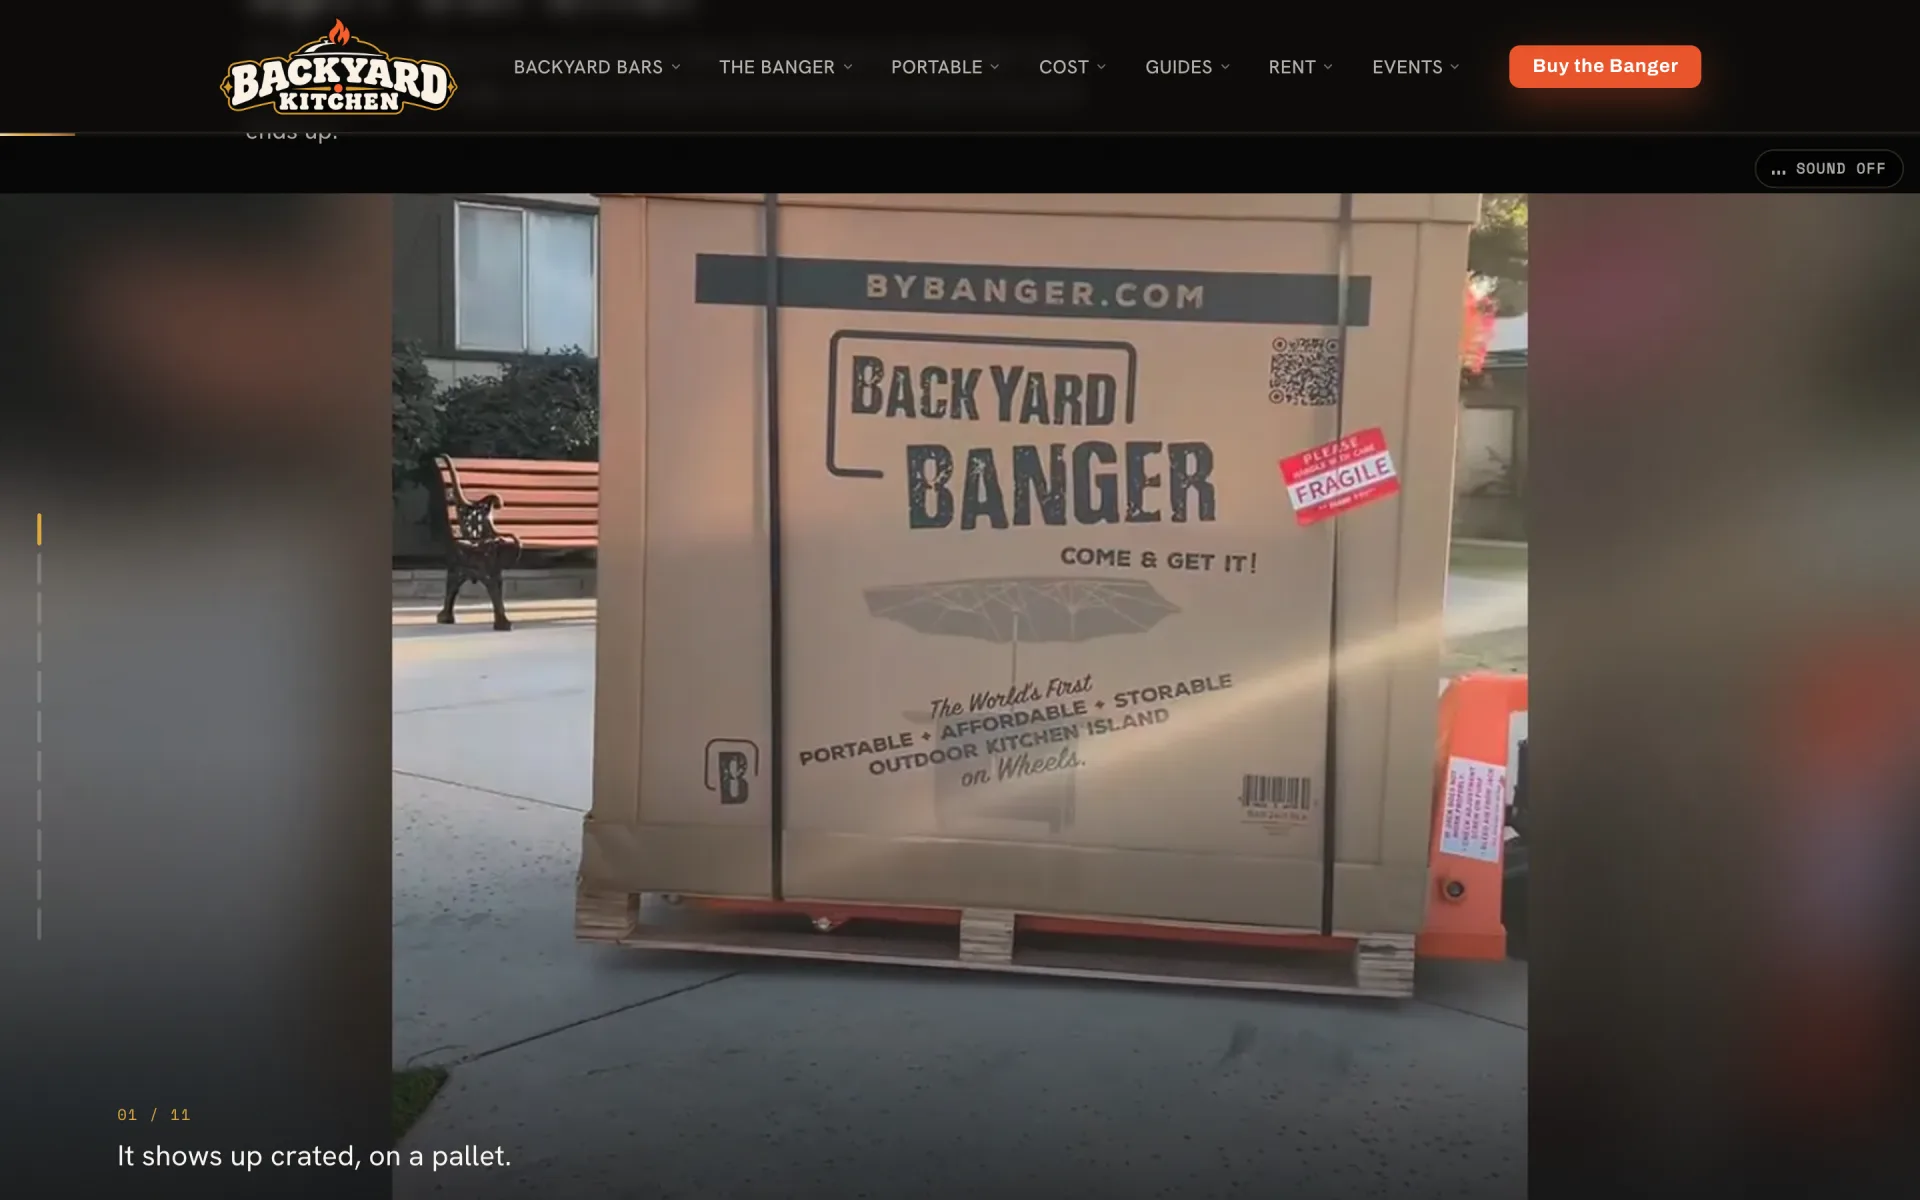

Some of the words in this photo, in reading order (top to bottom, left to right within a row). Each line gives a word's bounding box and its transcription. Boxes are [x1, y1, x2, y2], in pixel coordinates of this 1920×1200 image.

[866, 273, 1205, 310] BYBANGER.COM
[1303, 436, 1358, 464] PLEASE
[906, 440, 1216, 530] BANGER
[1295, 457, 1391, 504] FRAGILE
[1061, 547, 1131, 567] COME
[1141, 551, 1158, 568] &
[1167, 552, 1215, 570] GET
[1224, 552, 1257, 574] IT!
[799, 732, 914, 767] PORTABLE
[940, 699, 1088, 741] AFFORDABLE
[1113, 673, 1233, 708] STORABLE
[930, 698, 964, 720] The
[969, 682, 1041, 712] World's
[1046, 673, 1093, 698] First
[868, 743, 978, 776] OUTDOOR
[986, 724, 1079, 755] KITCHEN
[1086, 708, 1170, 736] ISLAND
[718, 751, 749, 805] B
[961, 769, 991, 788] on
[998, 746, 1086, 782] Wheels.
